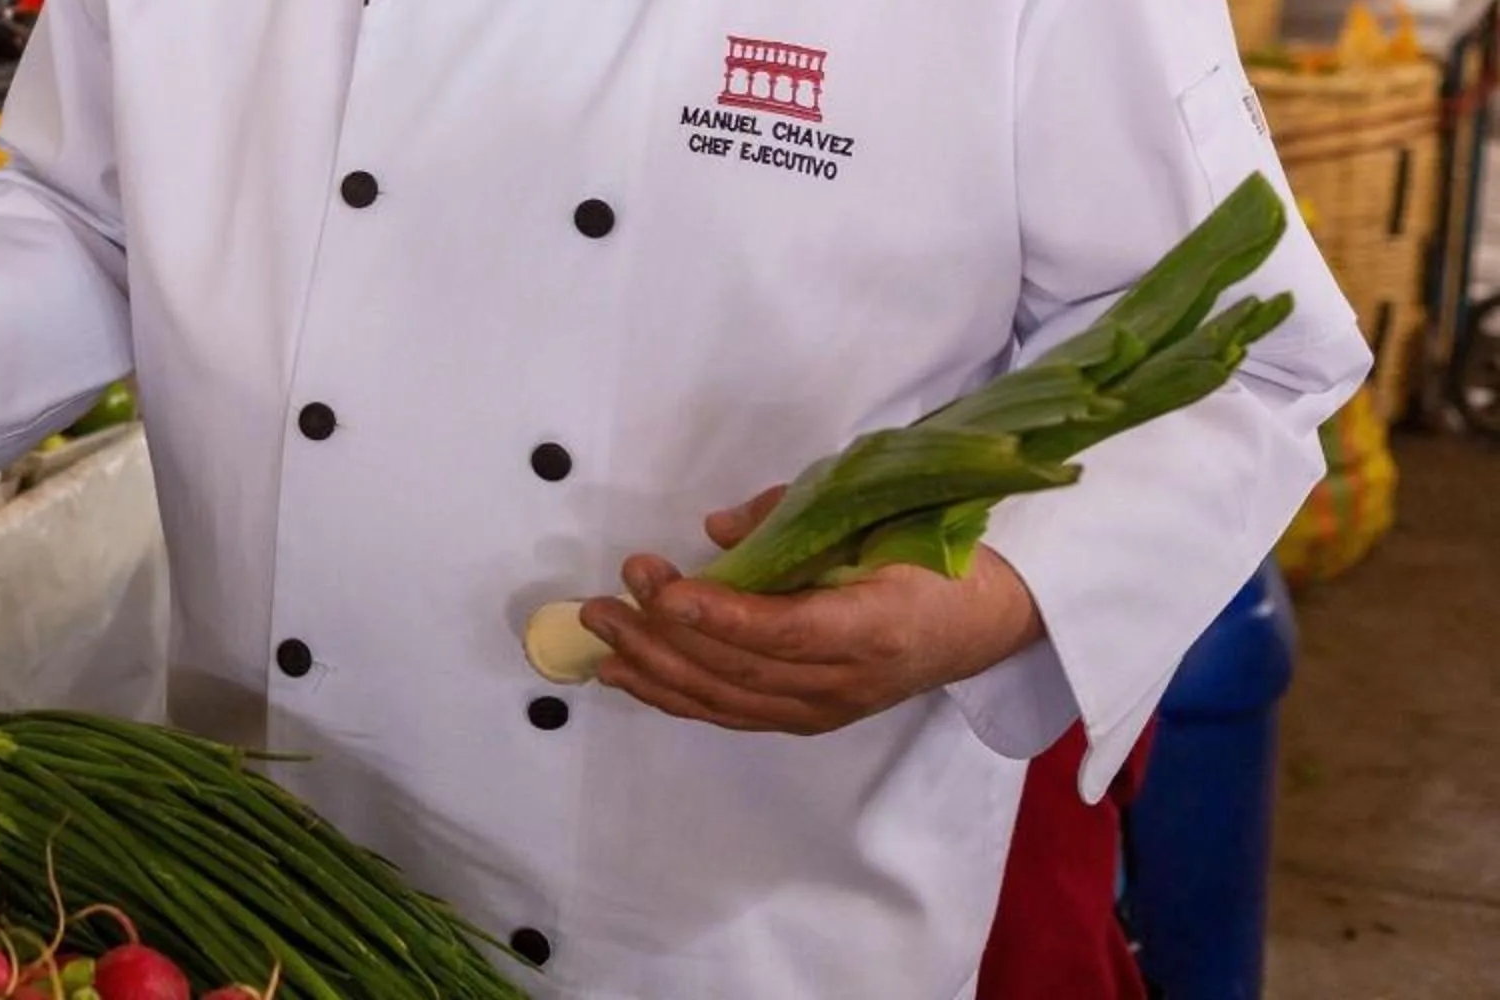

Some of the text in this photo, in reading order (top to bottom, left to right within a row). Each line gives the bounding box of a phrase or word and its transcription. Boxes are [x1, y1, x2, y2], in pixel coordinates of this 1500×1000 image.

[680, 106, 855, 157] MANUEL CHAVEZ
[688, 134, 838, 180] CHEF EJECUTIVO
